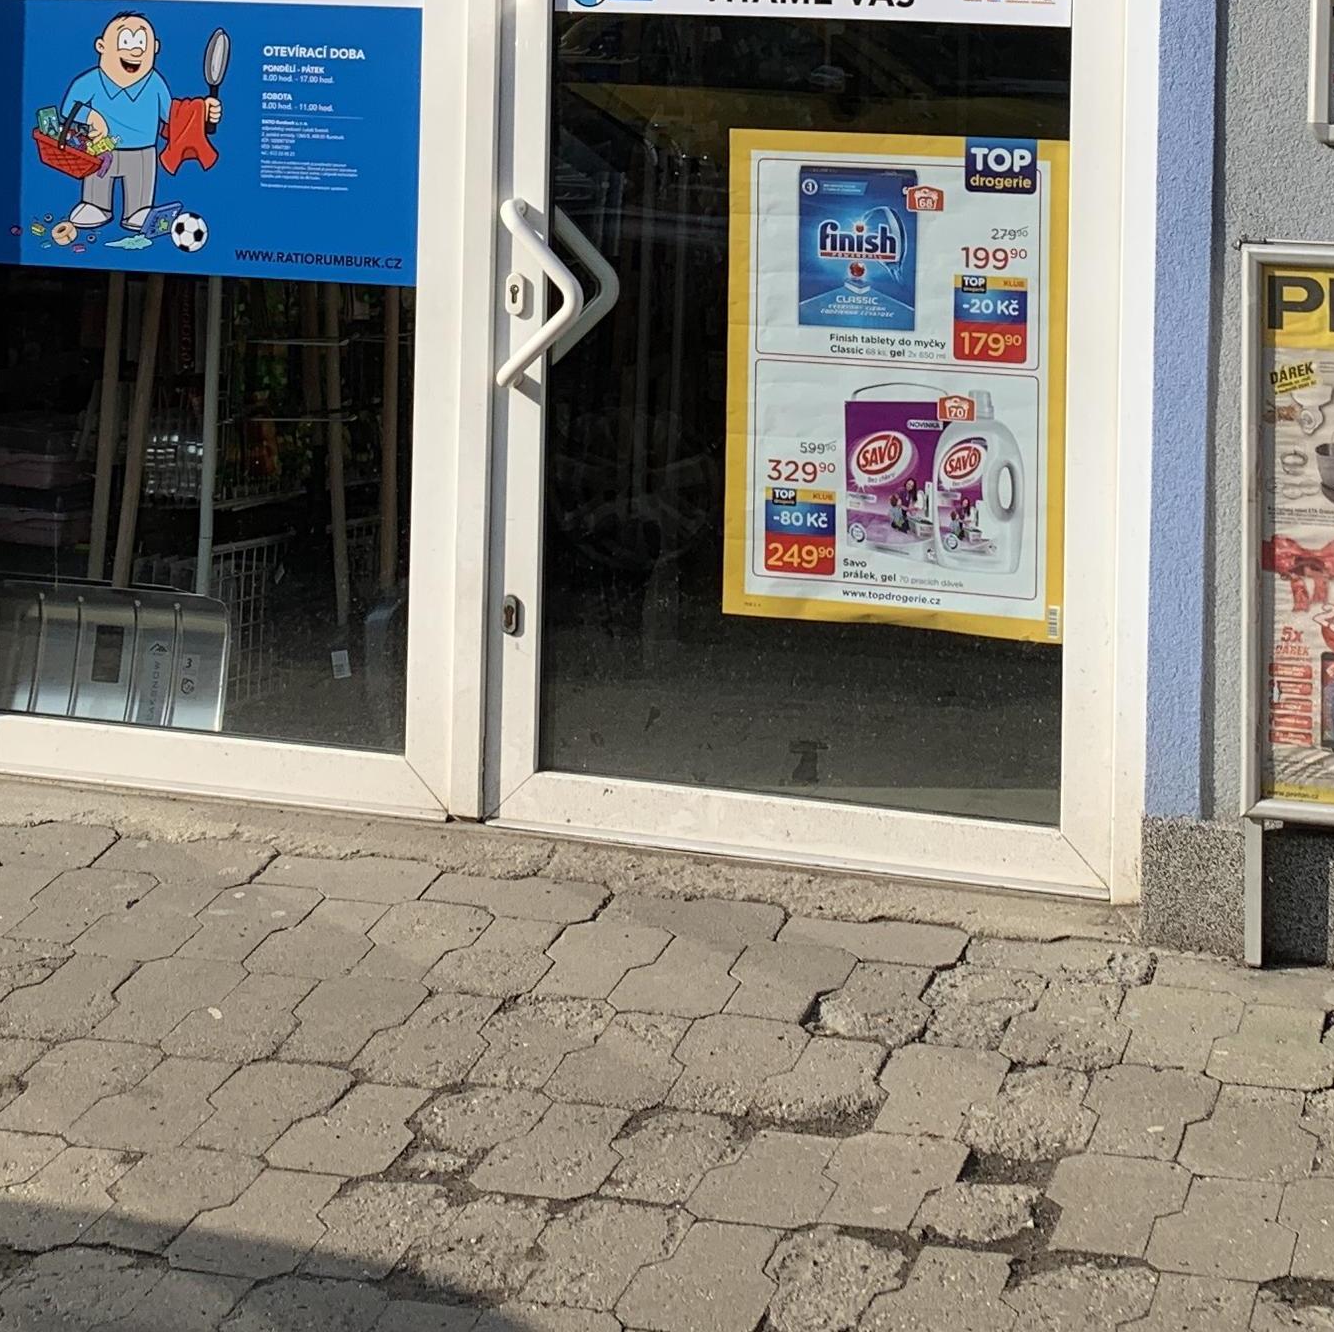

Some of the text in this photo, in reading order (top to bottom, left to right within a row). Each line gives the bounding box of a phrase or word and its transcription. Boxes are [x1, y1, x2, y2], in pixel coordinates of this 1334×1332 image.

[263, 44, 366, 60] OTEVÍRACÍ DOBA
[262, 92, 293, 101] SOBOTA
[971, 147, 1032, 173] TOP
[970, 174, 1032, 189] drogerie
[818, 221, 897, 254] finish
[235, 249, 403, 269] WWW.RATIORUMBURK.CZ
[963, 276, 986, 287] TOP
[836, 295, 879, 305] CLASSIC
[997, 299, 1019, 316] Kč
[829, 333, 946, 349] Finish tablety do myčky
[830, 344, 863, 355] Classic
[889, 348, 905, 358] gel
[1270, 361, 1315, 384] DÁREK
[950, 407, 965, 418] 70
[909, 421, 941, 429] NOVINKA
[860, 436, 902, 468] SAVO
[946, 446, 980, 475] SAVO
[773, 489, 795, 499] TOP
[807, 512, 828, 528] Kč
[843, 558, 867, 567] Savo
[881, 573, 896, 582] gel
[842, 589, 941, 605] www.topdrogerie.cz
